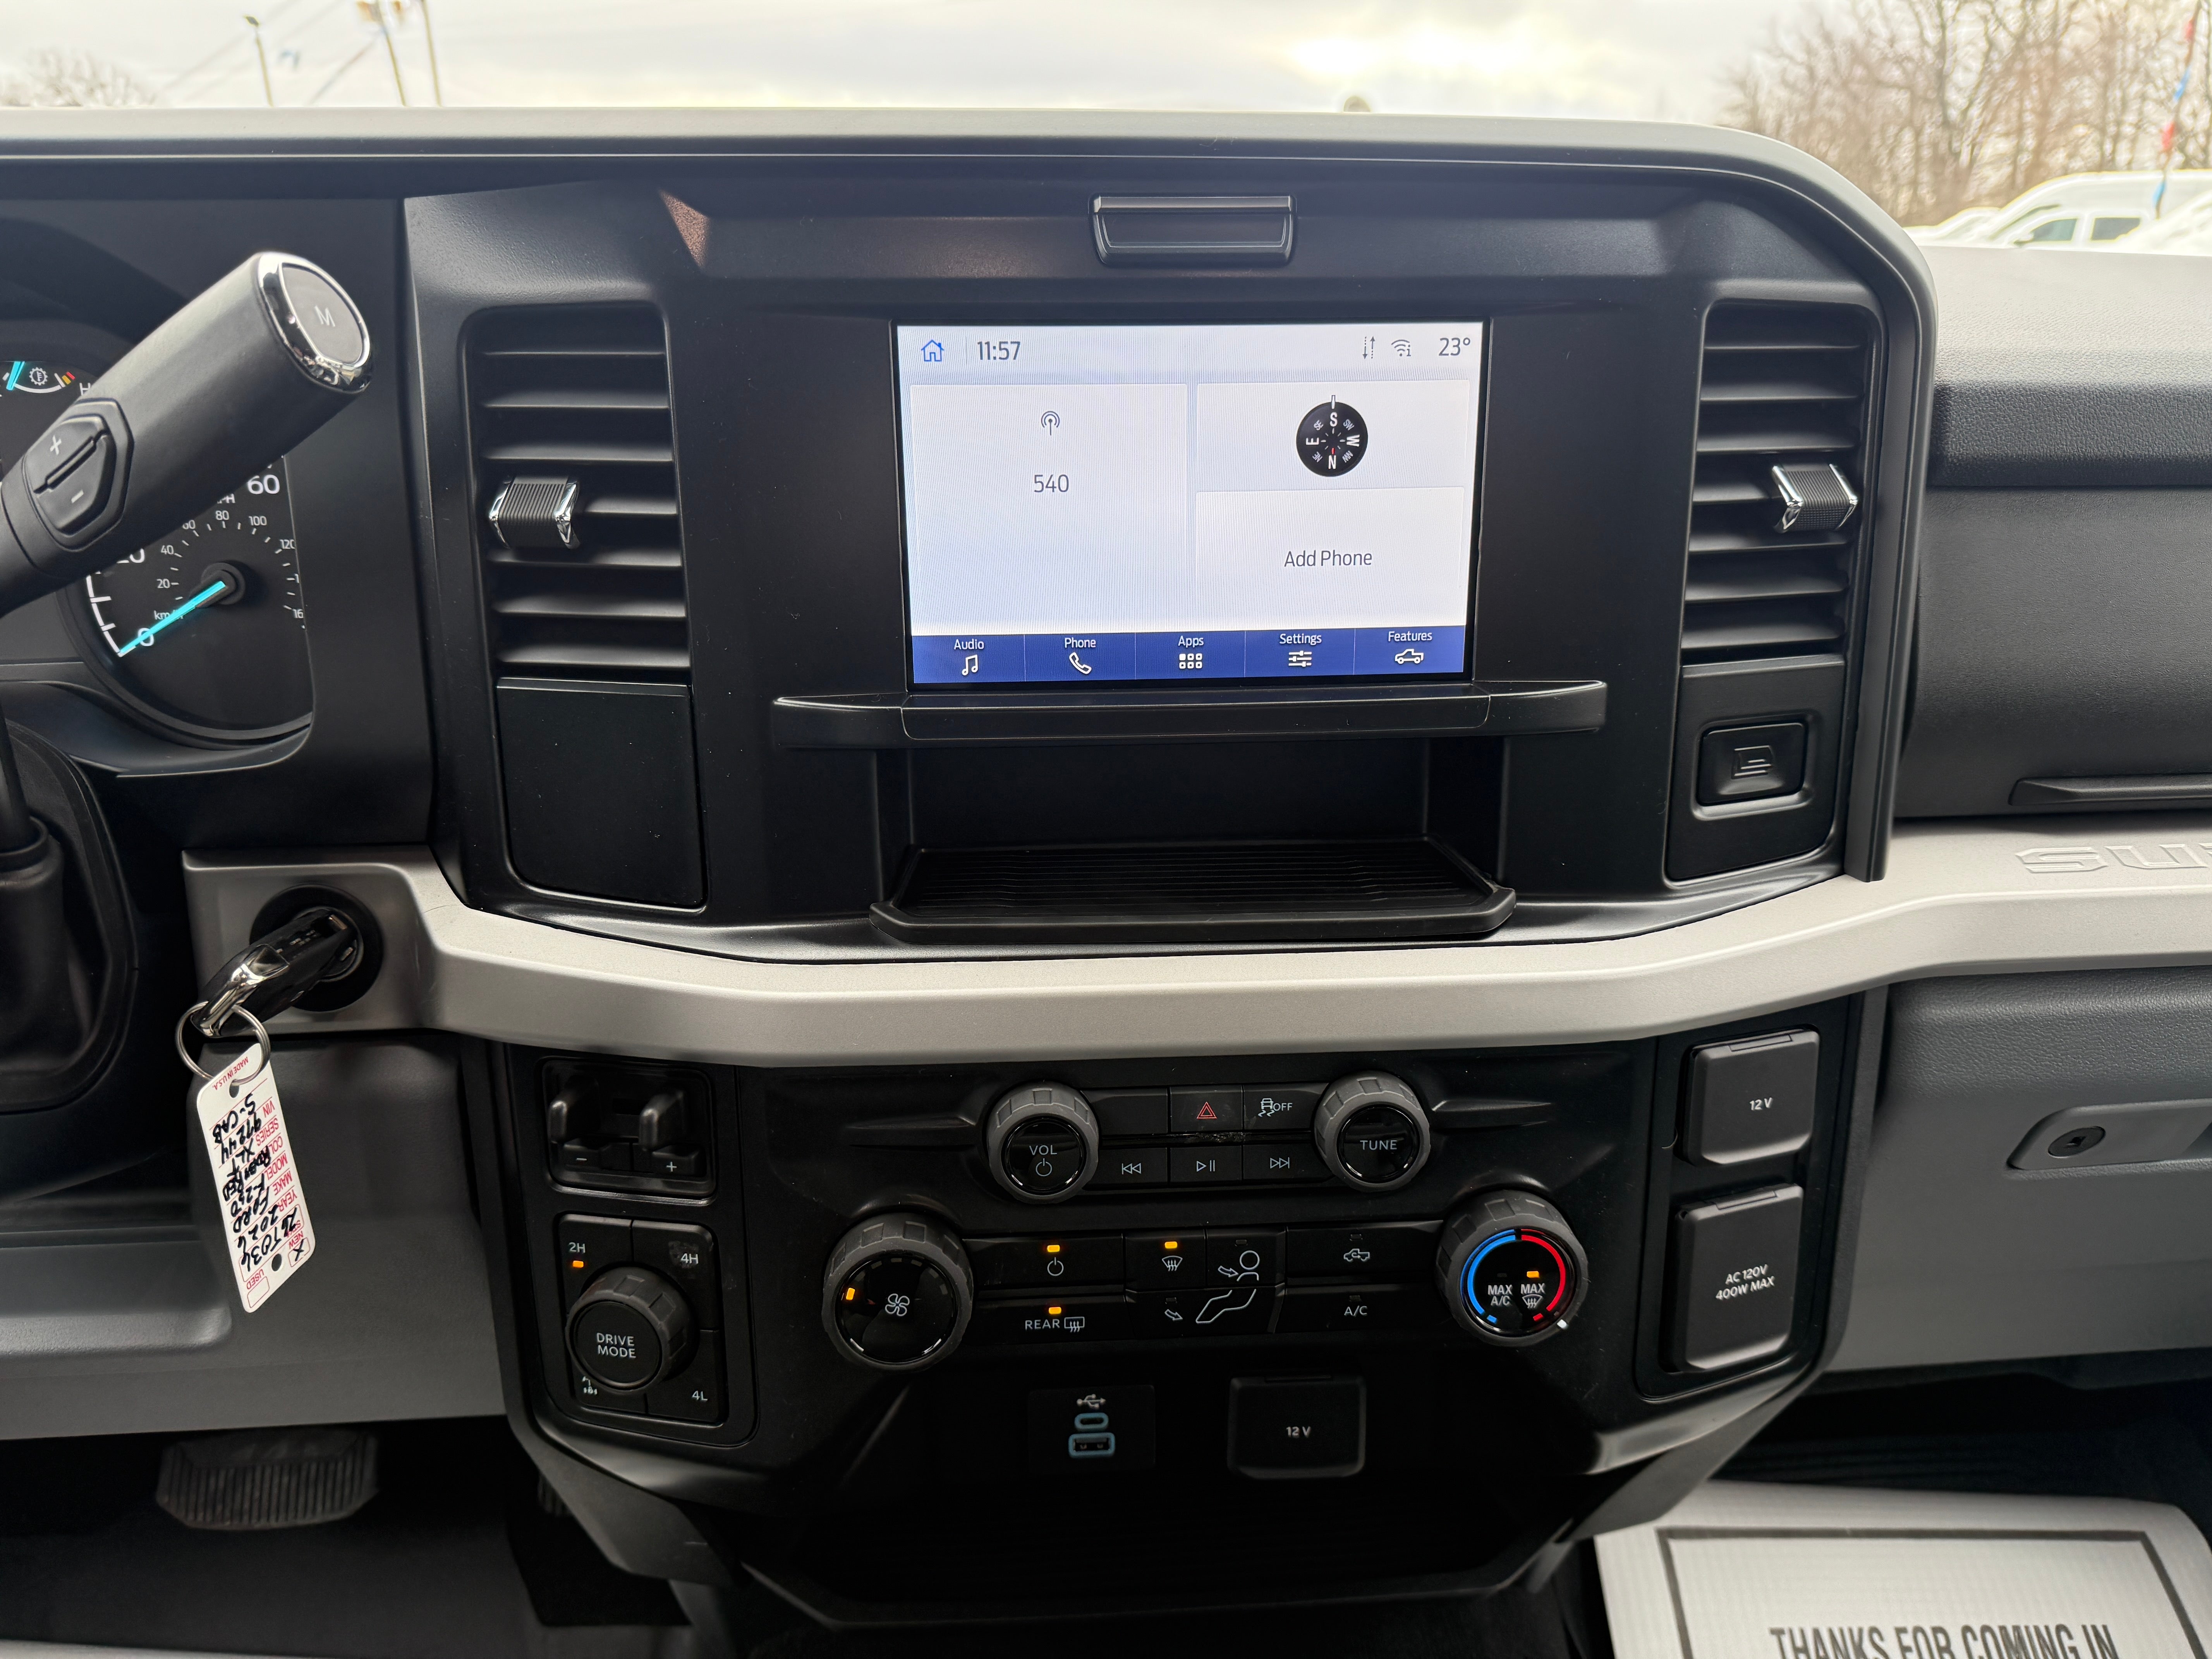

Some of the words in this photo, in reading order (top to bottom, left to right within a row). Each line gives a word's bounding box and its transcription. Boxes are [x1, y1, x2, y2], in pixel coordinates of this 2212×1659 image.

[314, 305, 335, 327] M
[977, 341, 1021, 361] 11:57
[1439, 337, 1471, 356] 23°
[1314, 420, 1324, 431] SE
[1330, 412, 1338, 427] S
[1343, 419, 1355, 431] SW
[1346, 434, 1360, 447] W
[1328, 455, 1336, 469] N
[247, 474, 280, 495] 60
[1033, 474, 1070, 494] 540
[215, 510, 229, 521] 80
[249, 515, 267, 526] 100
[161, 545, 174, 555] 40
[1285, 550, 1317, 568] Add
[1321, 550, 1373, 567] Phone
[157, 579, 170, 589] 20
[1065, 637, 1096, 648] Phone
[1178, 635, 1204, 647] Apps
[1279, 633, 1322, 646] Settings
[1388, 631, 1432, 642] Features
[954, 639, 984, 650] Audio
[2015, 843, 2212, 874] SU
[234, 1056, 249, 1074] MADE
[263, 1100, 275, 1118] VIN
[1273, 1101, 1293, 1112] OFF
[1749, 1099, 1762, 1110] 12
[1763, 1097, 1773, 1108] V
[256, 1118, 279, 1146] SERIES
[1029, 1145, 1058, 1155] VOL
[1360, 1140, 1397, 1151] TUNE
[264, 1152, 288, 1180] MODEL
[273, 1170, 293, 1196] MAKE
[278, 1189, 297, 1212] YEAR
[289, 1231, 304, 1247] NEW
[568, 1242, 586, 1253] 2H
[681, 1253, 699, 1264] 4H
[246, 1269, 264, 1290] USED
[1725, 1273, 1741, 1285] AC
[1742, 1264, 1769, 1279] 120V
[1487, 1285, 1512, 1296] MAX
[1520, 1284, 1545, 1294] MAX
[1715, 1285, 1749, 1300] 400W
[1750, 1275, 1775, 1290] MAX
[1490, 1295, 1510, 1306] A/C
[1344, 1306, 1367, 1316] A/C
[1025, 1319, 1060, 1330] REAR
[596, 1333, 635, 1346] DRIVE
[598, 1345, 636, 1358] MODE
[692, 1391, 708, 1401] 4L
[1286, 1426, 1299, 1437] 12
[1302, 1426, 1311, 1436] V
[1769, 1626, 1890, 1659] THANKS
[1895, 1626, 1956, 1659] FOR
[1961, 1624, 2081, 1659] COMING
[2081, 1624, 2120, 1659] IN
